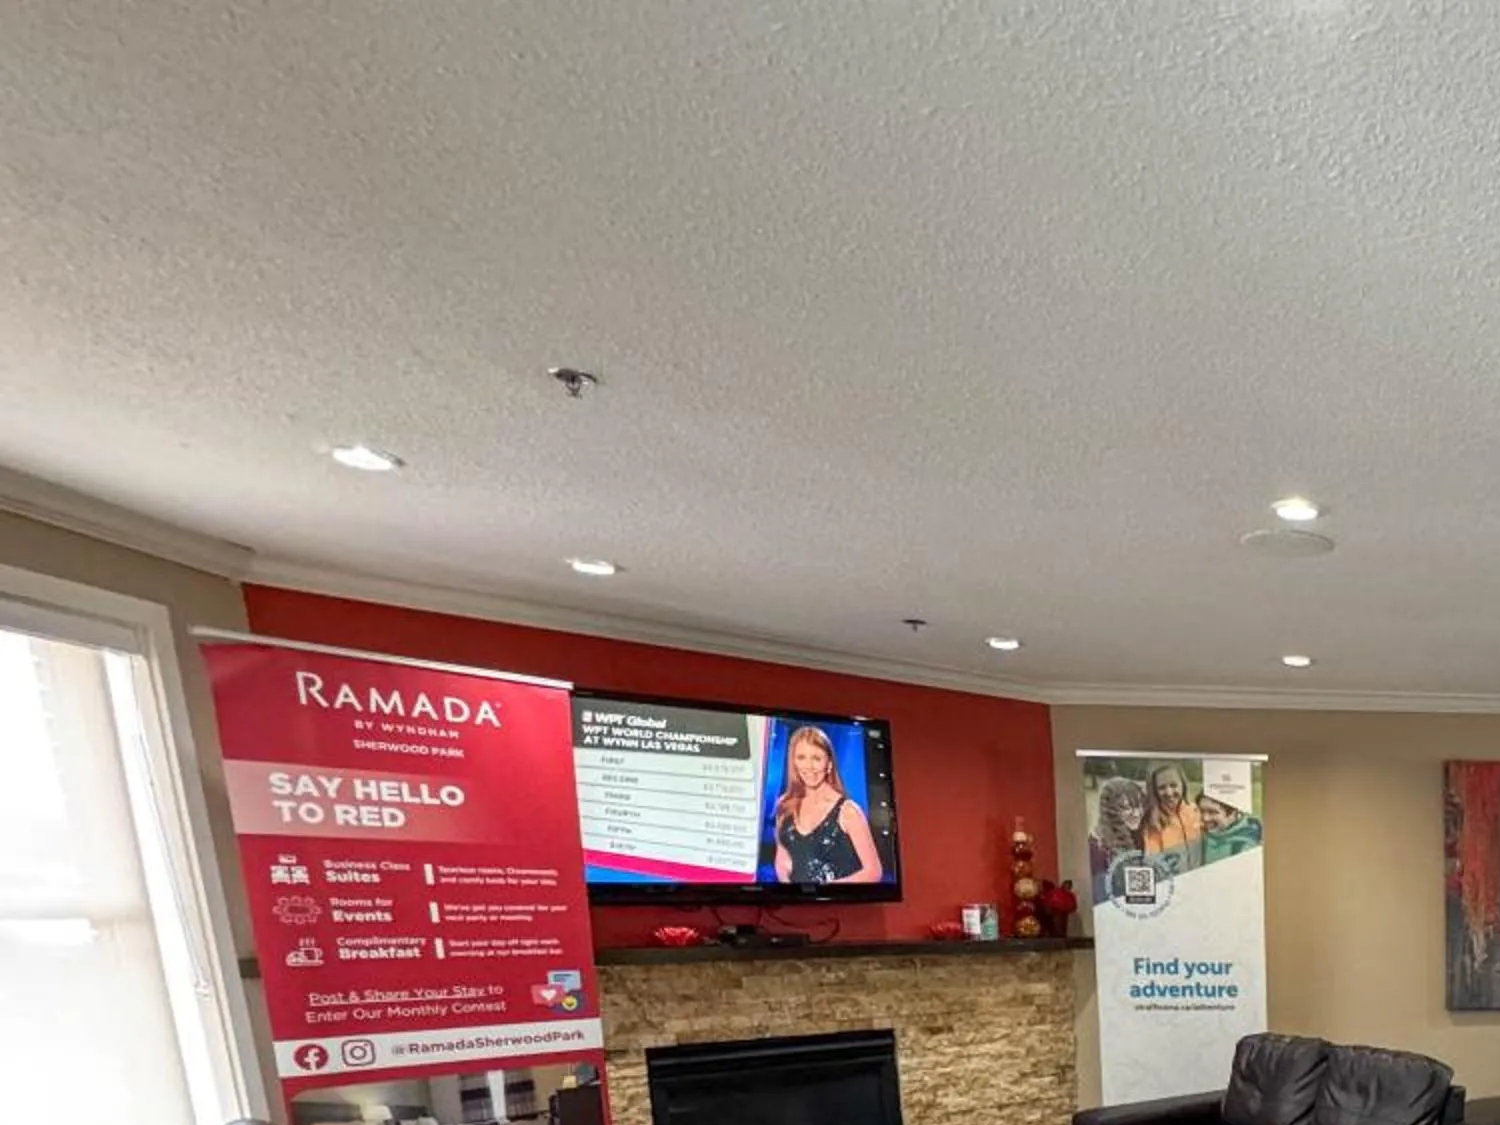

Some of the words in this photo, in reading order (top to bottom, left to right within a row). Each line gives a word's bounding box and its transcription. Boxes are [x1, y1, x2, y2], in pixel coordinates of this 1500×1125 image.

[296, 671, 501, 727] RAMADA
[353, 719, 374, 731] BY
[381, 722, 460, 740] WYNDHAM
[627, 715, 667, 729] Global
[582, 725, 607, 736] WPT
[612, 727, 653, 739] WORLD
[656, 732, 738, 746] CHAMPIONSHIP
[584, 735, 599, 745] AT
[602, 737, 639, 748] WYNN
[641, 740, 661, 750] LAS
[663, 742, 701, 753] VEGAS
[353, 739, 429, 756] SHERWOOD
[431, 747, 465, 759] PARK
[269, 772, 343, 799] SAY
[353, 778, 465, 806] HELLO
[272, 800, 325, 824] TO
[334, 804, 406, 828] RED
[323, 859, 377, 871] Business
[380, 861, 411, 872] Class
[325, 870, 381, 884] Suites
[329, 897, 373, 908] Rooms
[375, 897, 393, 908] for
[332, 910, 393, 923] Events
[336, 937, 426, 947] Complimentary
[339, 946, 423, 960] Breakfast
[1133, 957, 1179, 975] Find
[1184, 962, 1233, 979] your
[308, 992, 345, 1007] Post
[349, 990, 361, 1004] &
[363, 988, 409, 1002] Share
[413, 987, 447, 999] Your
[454, 985, 487, 999] Stay
[489, 985, 504, 995] to
[1130, 980, 1239, 998] adventure
[305, 1011, 347, 1024] Enter
[352, 1007, 383, 1020] Our
[387, 1002, 448, 1018] Monthly
[452, 1000, 507, 1013] Contest
